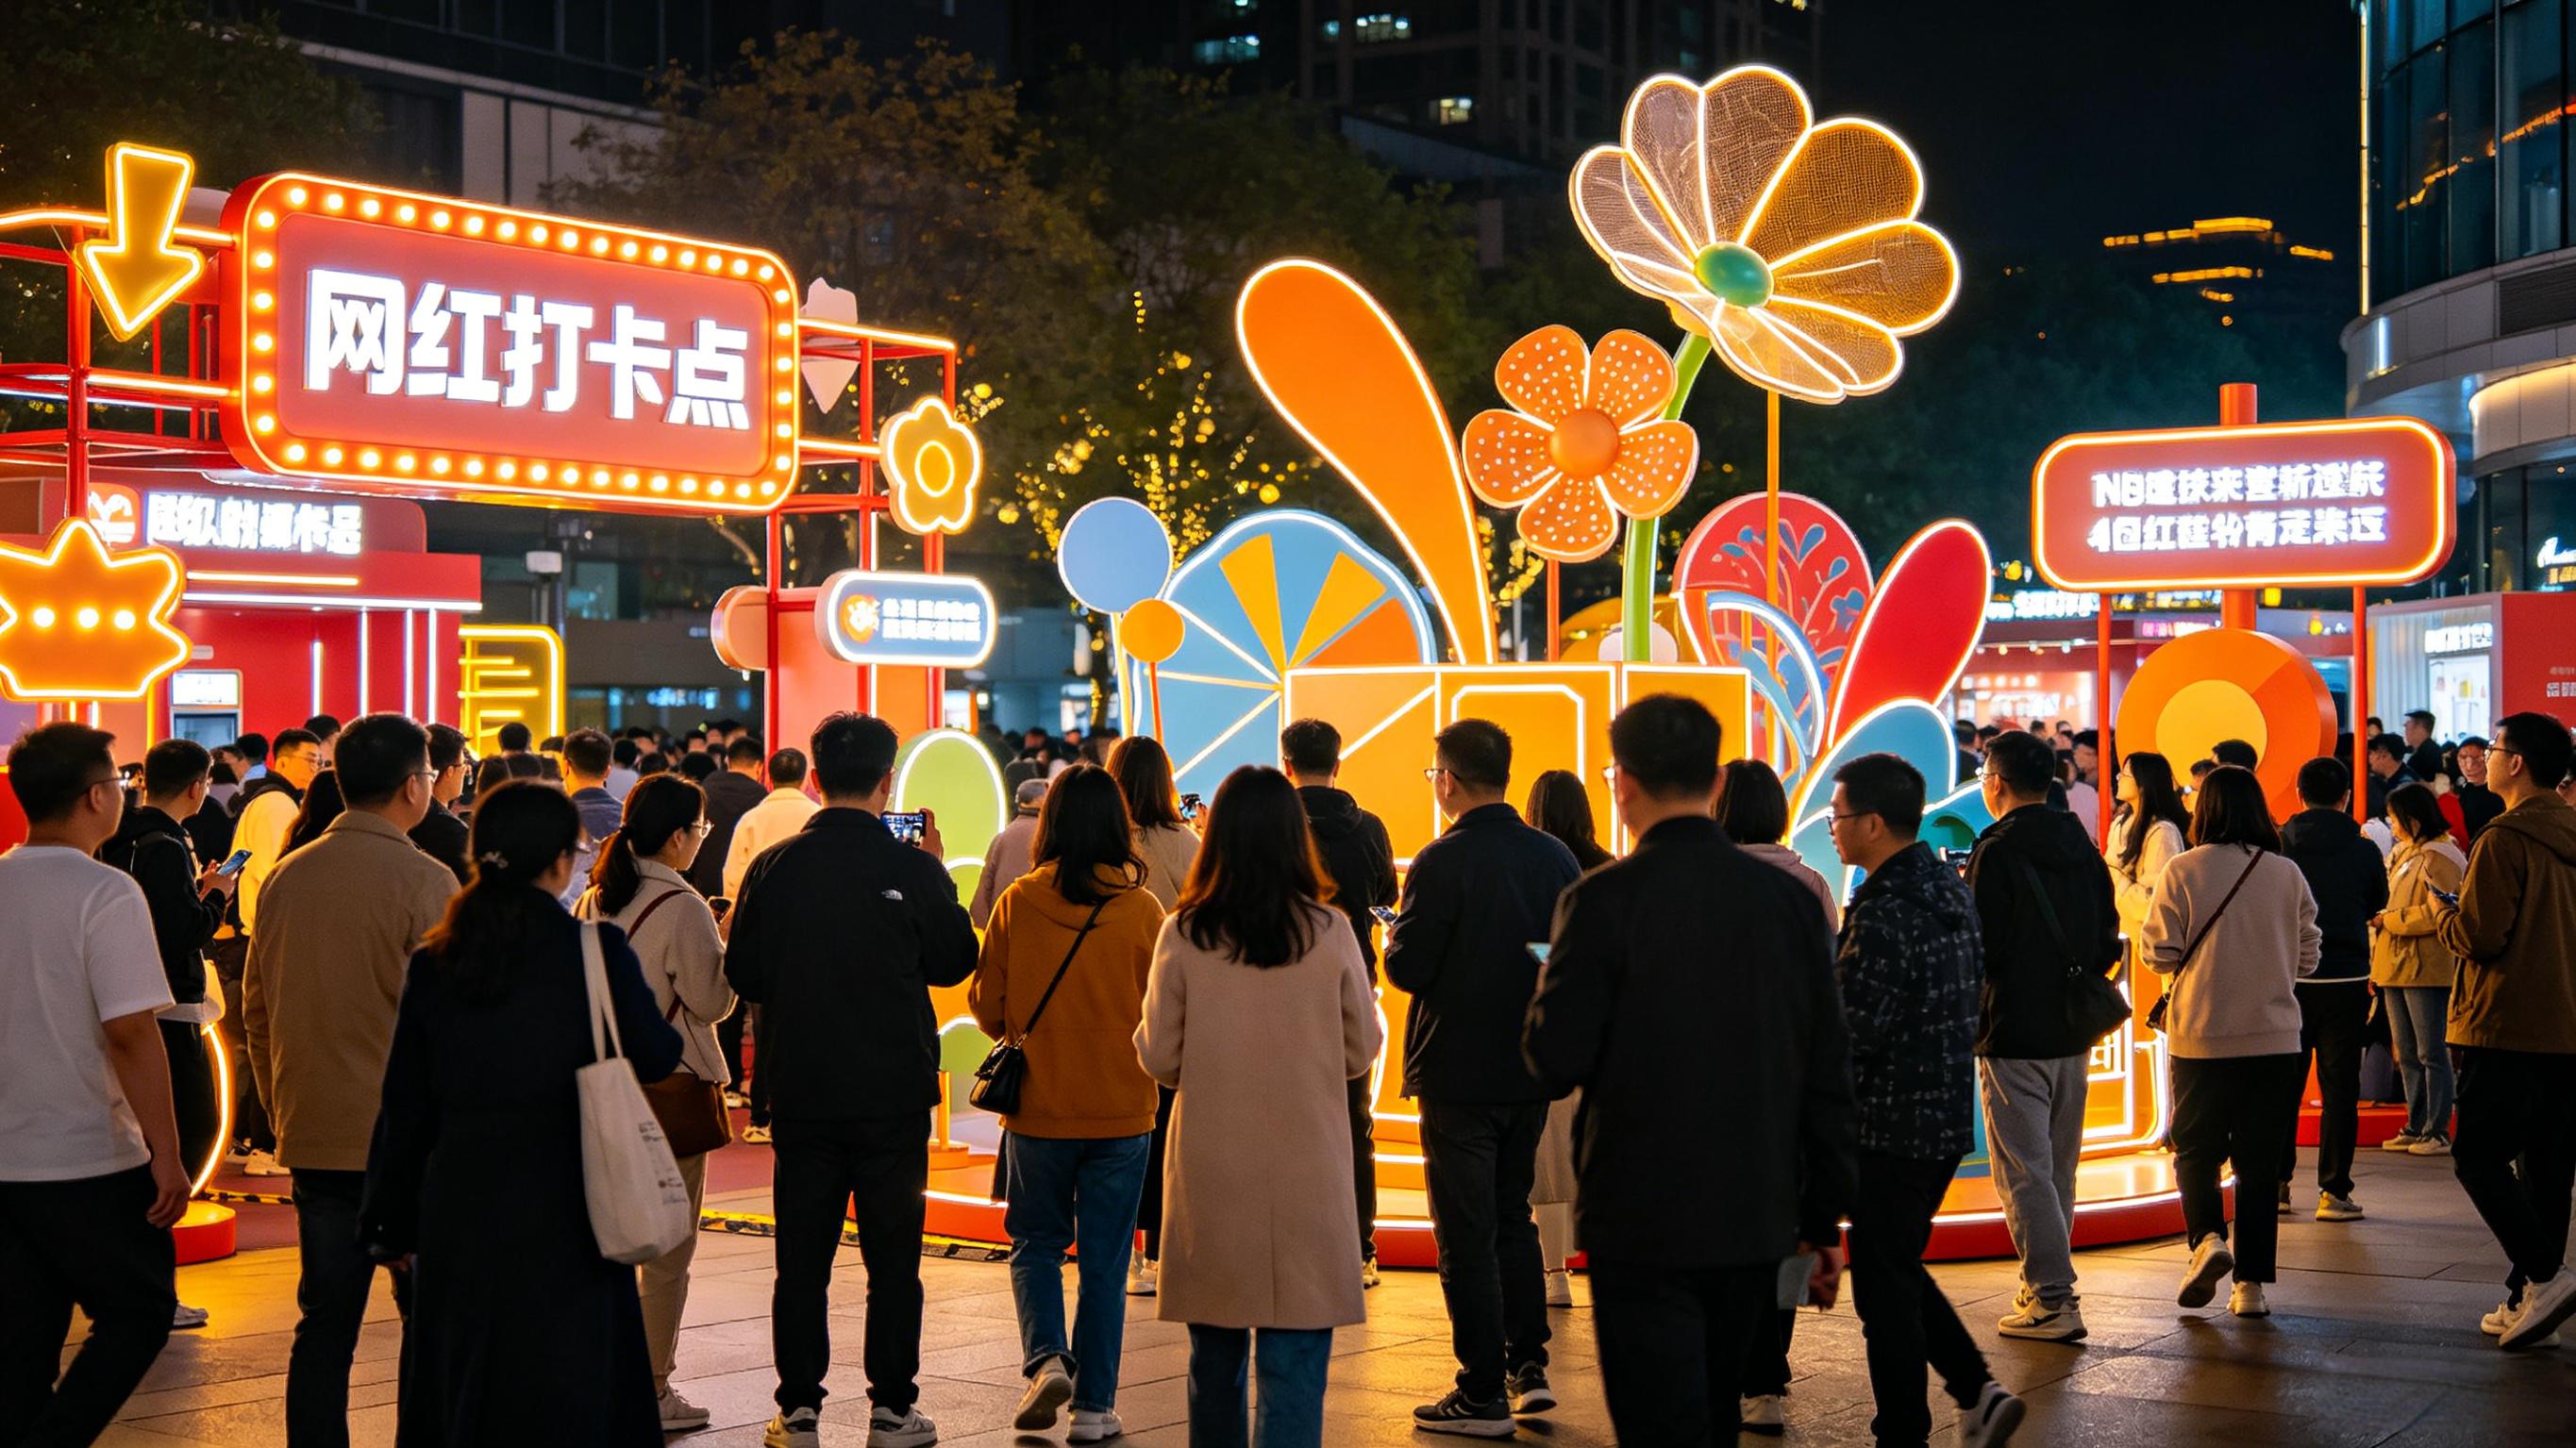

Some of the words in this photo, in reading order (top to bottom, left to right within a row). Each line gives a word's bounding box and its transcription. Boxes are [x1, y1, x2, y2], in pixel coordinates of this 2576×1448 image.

[303, 269, 750, 430] 网红打卡点
